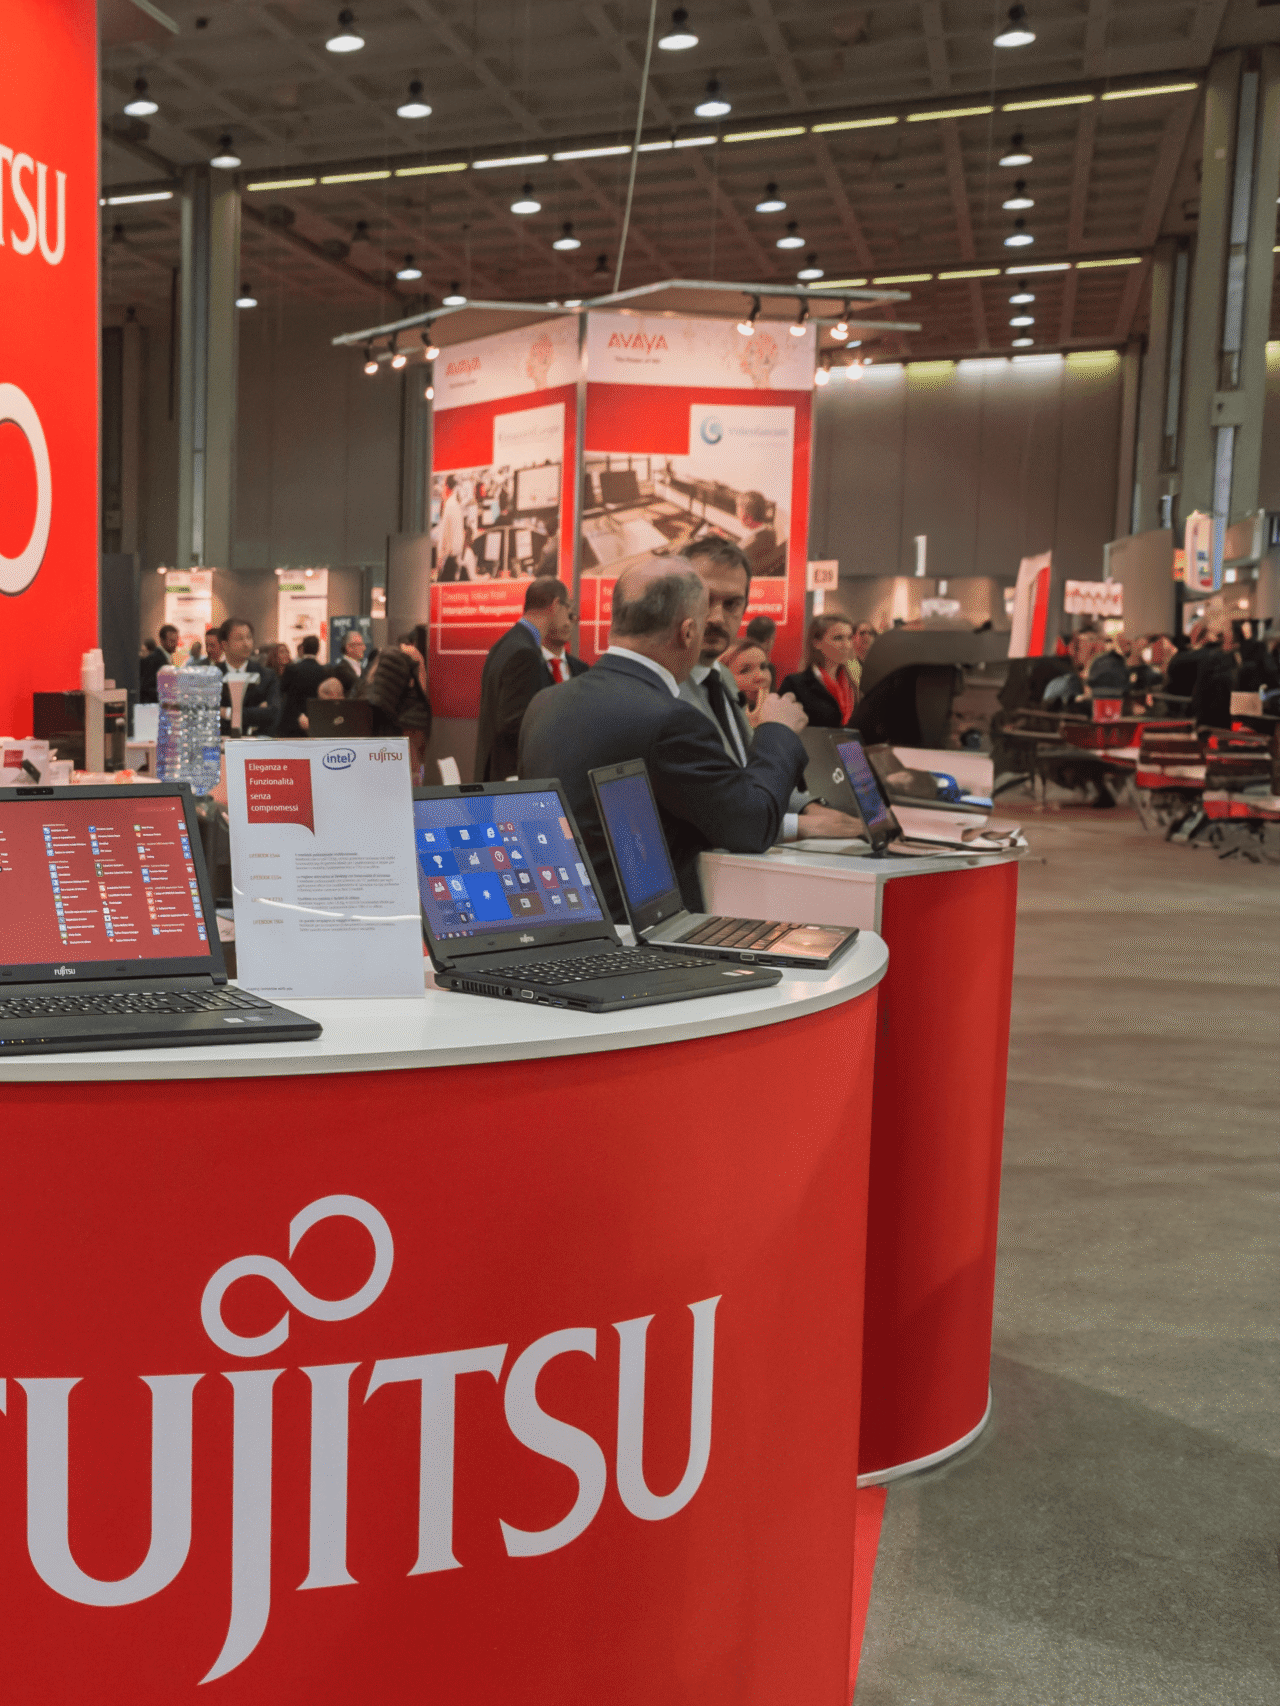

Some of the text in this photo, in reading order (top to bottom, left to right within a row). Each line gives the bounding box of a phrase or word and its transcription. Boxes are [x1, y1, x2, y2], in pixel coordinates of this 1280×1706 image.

[607, 333, 669, 356] AVAYA
[368, 752, 403, 763] FUJITSU
[248, 763, 282, 773] Eleganza
[249, 777, 294, 786] Funzionalità
[250, 792, 272, 800] senza
[250, 802, 299, 813] compromessi
